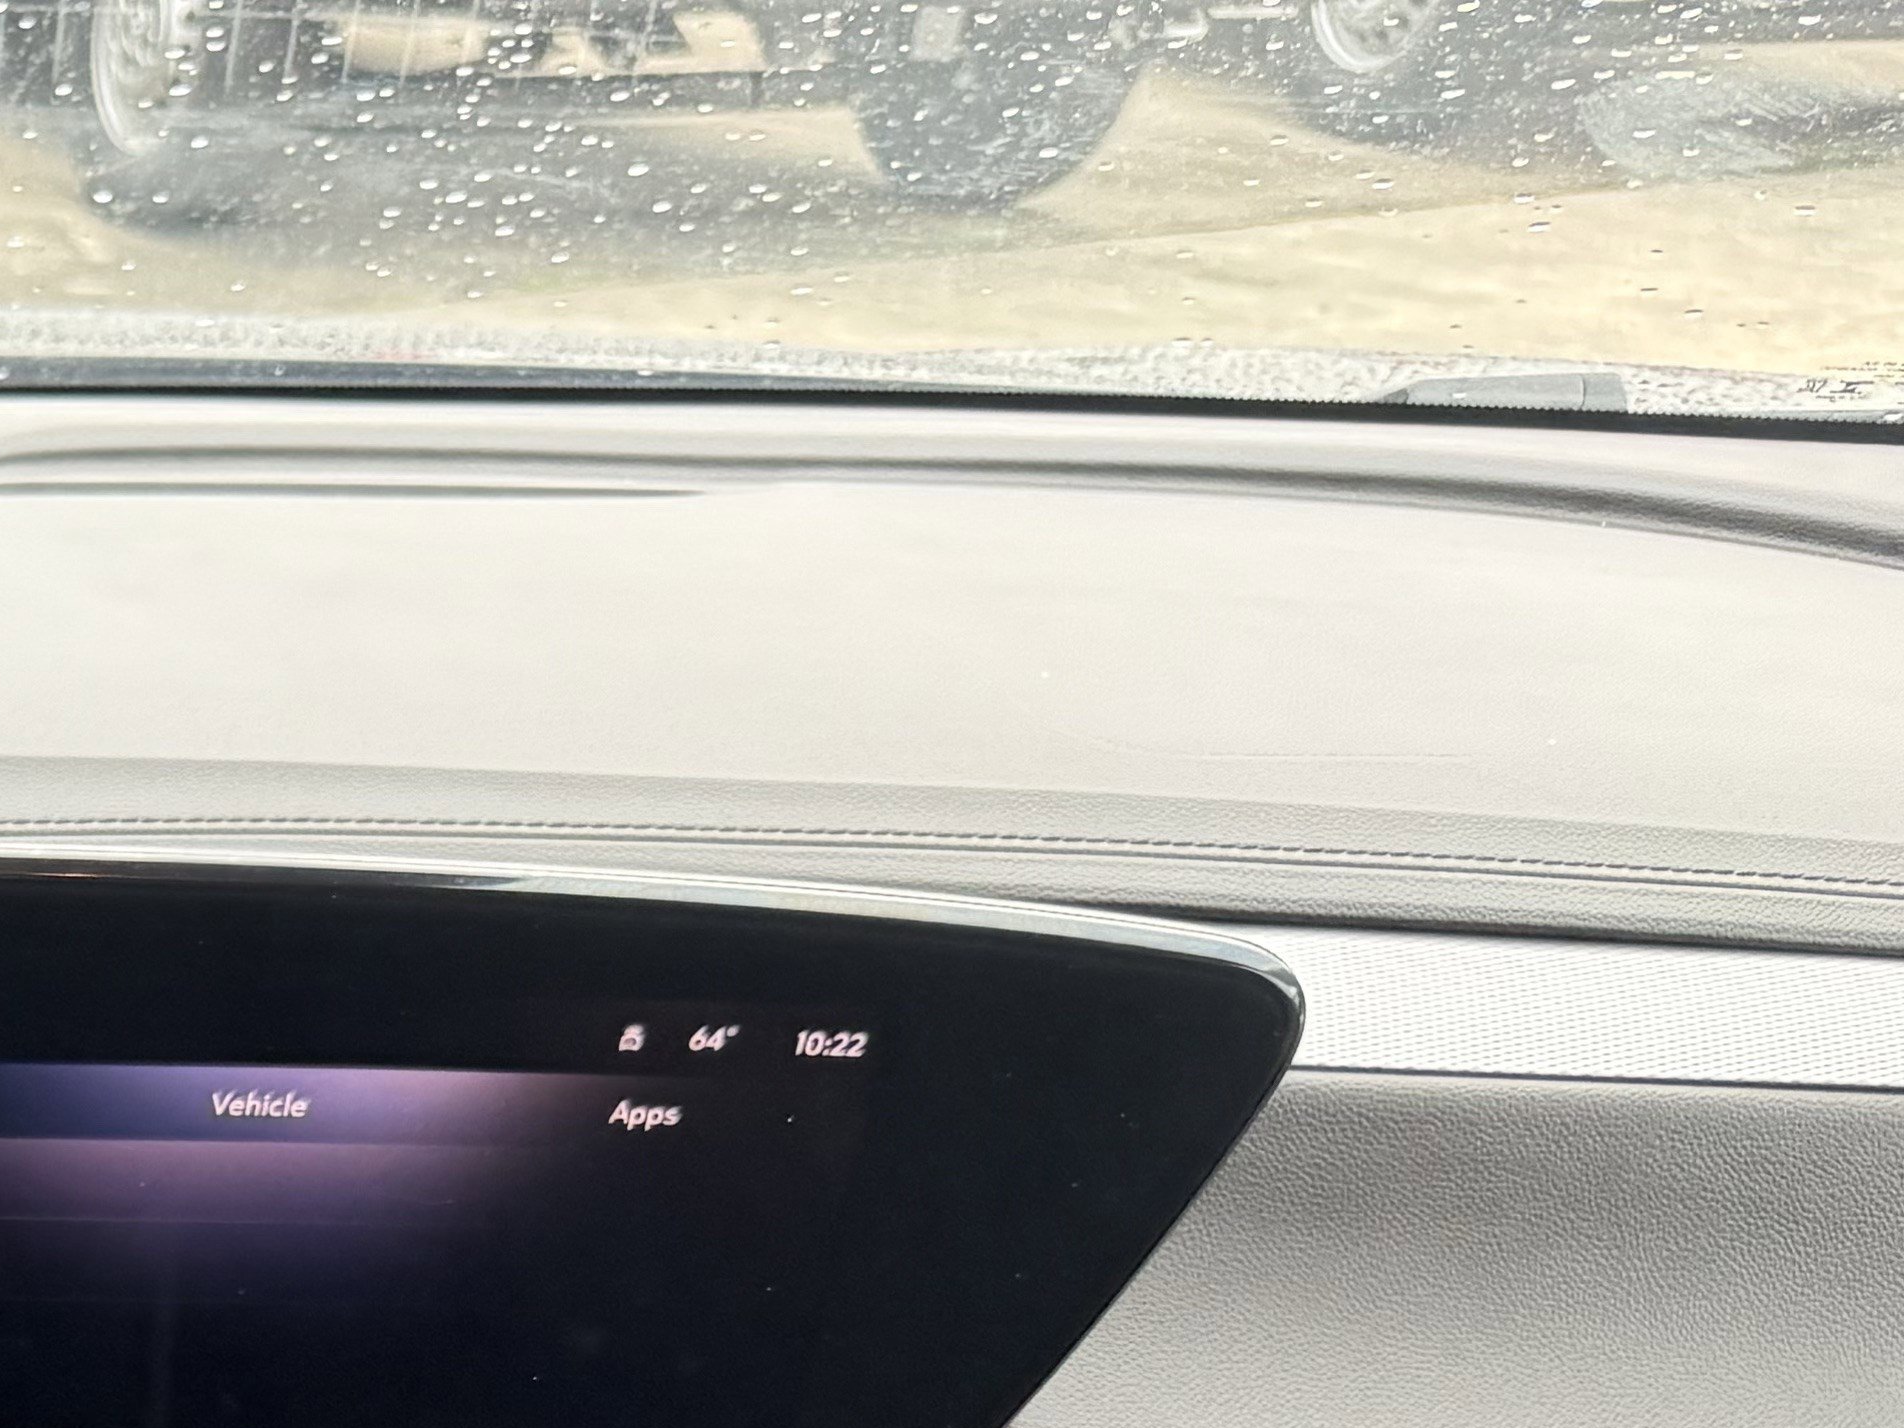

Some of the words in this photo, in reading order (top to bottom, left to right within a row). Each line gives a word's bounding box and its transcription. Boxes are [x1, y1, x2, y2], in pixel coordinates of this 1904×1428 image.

[688, 1026, 739, 1052] 64°
[795, 1030, 868, 1058] 10:22
[211, 1086, 312, 1118] Vehicle
[608, 1099, 681, 1132] Apps
